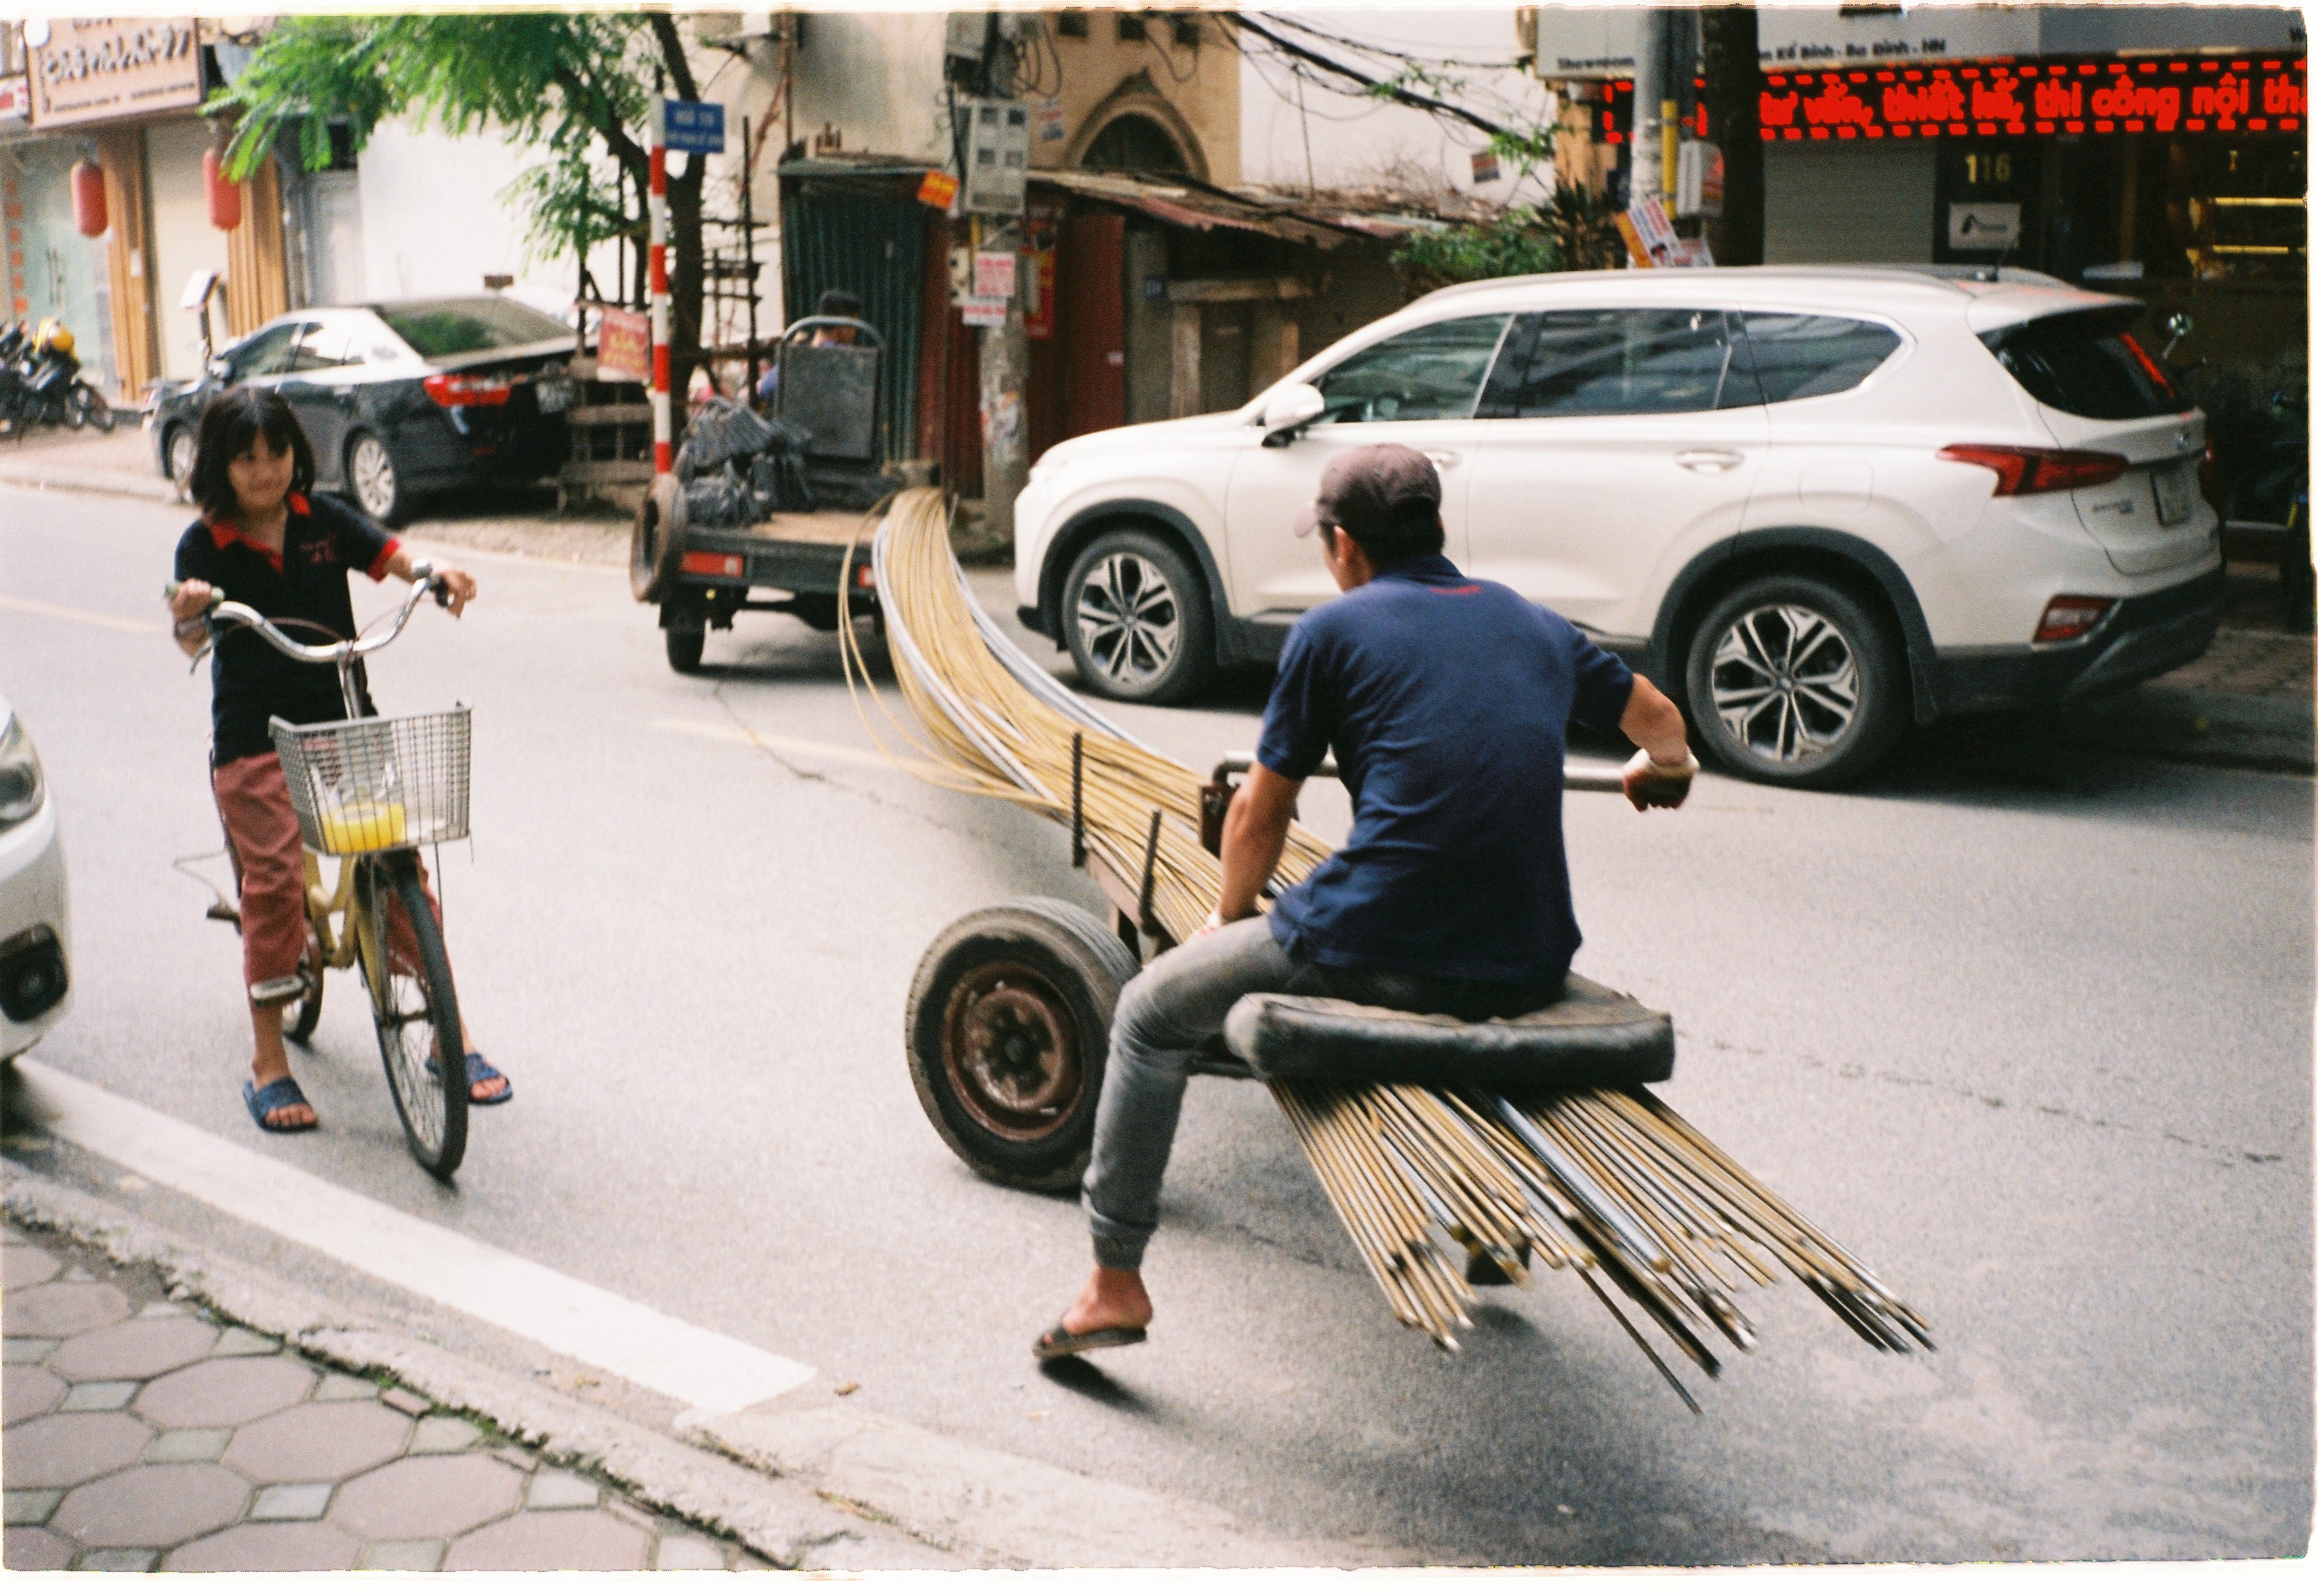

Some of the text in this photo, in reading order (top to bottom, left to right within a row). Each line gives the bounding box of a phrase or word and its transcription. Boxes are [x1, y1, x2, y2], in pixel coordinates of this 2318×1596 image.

[1557, 57, 1634, 70] Showroom
[1845, 41, 1867, 57] Ba
[2034, 78, 2082, 118] thi
[2091, 73, 2180, 131] công
[2192, 72, 2249, 122] nội
[1965, 153, 2011, 184] 116
